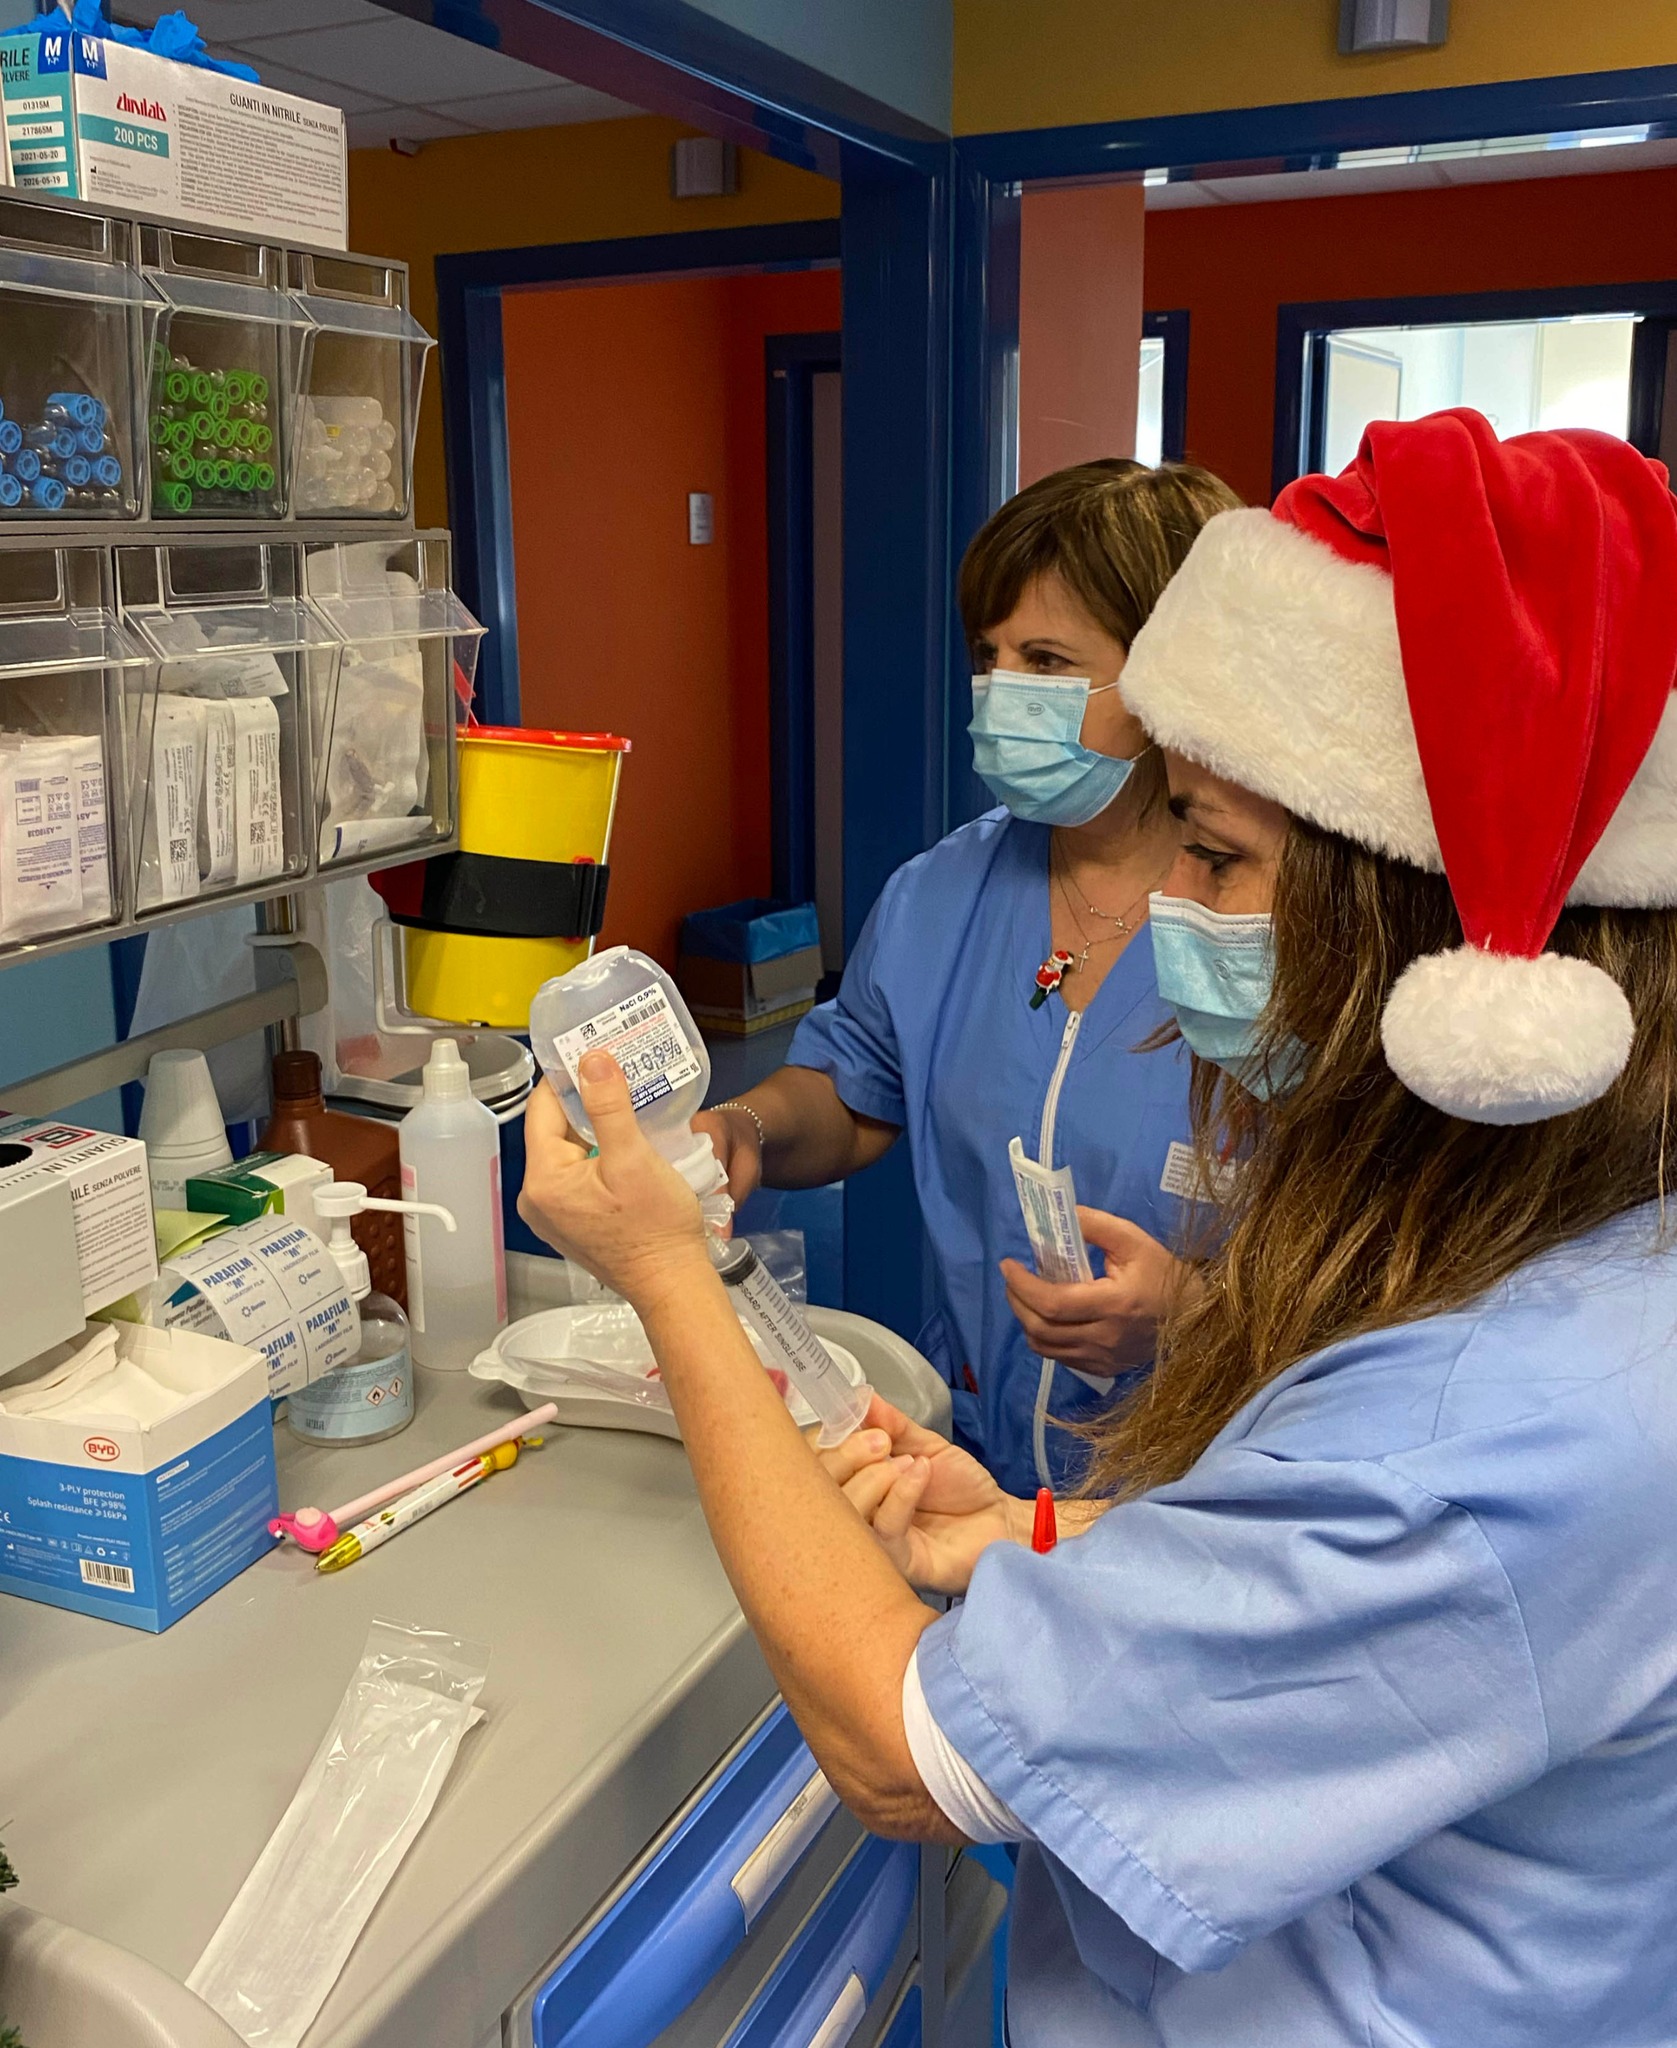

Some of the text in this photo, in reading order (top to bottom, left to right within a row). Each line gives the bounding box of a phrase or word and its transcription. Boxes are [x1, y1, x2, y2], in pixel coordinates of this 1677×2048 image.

[0, 48, 30, 68] RILE
[45, 36, 62, 57] M
[82, 38, 98, 62] M
[229, 93, 260, 113] GUANTI
[262, 103, 271, 115] IN
[272, 104, 301, 124] NITRILE
[114, 126, 158, 151] 200 PCS
[20, 151, 59, 162] 2021-05-20
[23, 175, 61, 186] 2026-05-19
[619, 987, 657, 1012] NaCl 0,9%
[66, 1138, 128, 1164] GUANTI
[92, 1177, 113, 1192] SENZA
[113, 1165, 142, 1184] POLVERE
[260, 1228, 308, 1258] PARAFILM
[202, 1256, 254, 1288] PARAFILM
[306, 1297, 350, 1333] PARAFILM
[736, 1281, 807, 1373] DISCARD AFTER SINGLE USE
[260, 1330, 296, 1359] RAFILM
[88, 1443, 116, 1456] BYD
[59, 1483, 125, 1500] 3-PLY protection
[83, 1497, 99, 1506] BFE
[27, 1496, 53, 1509] Splash
[53, 1502, 93, 1516] resistance
